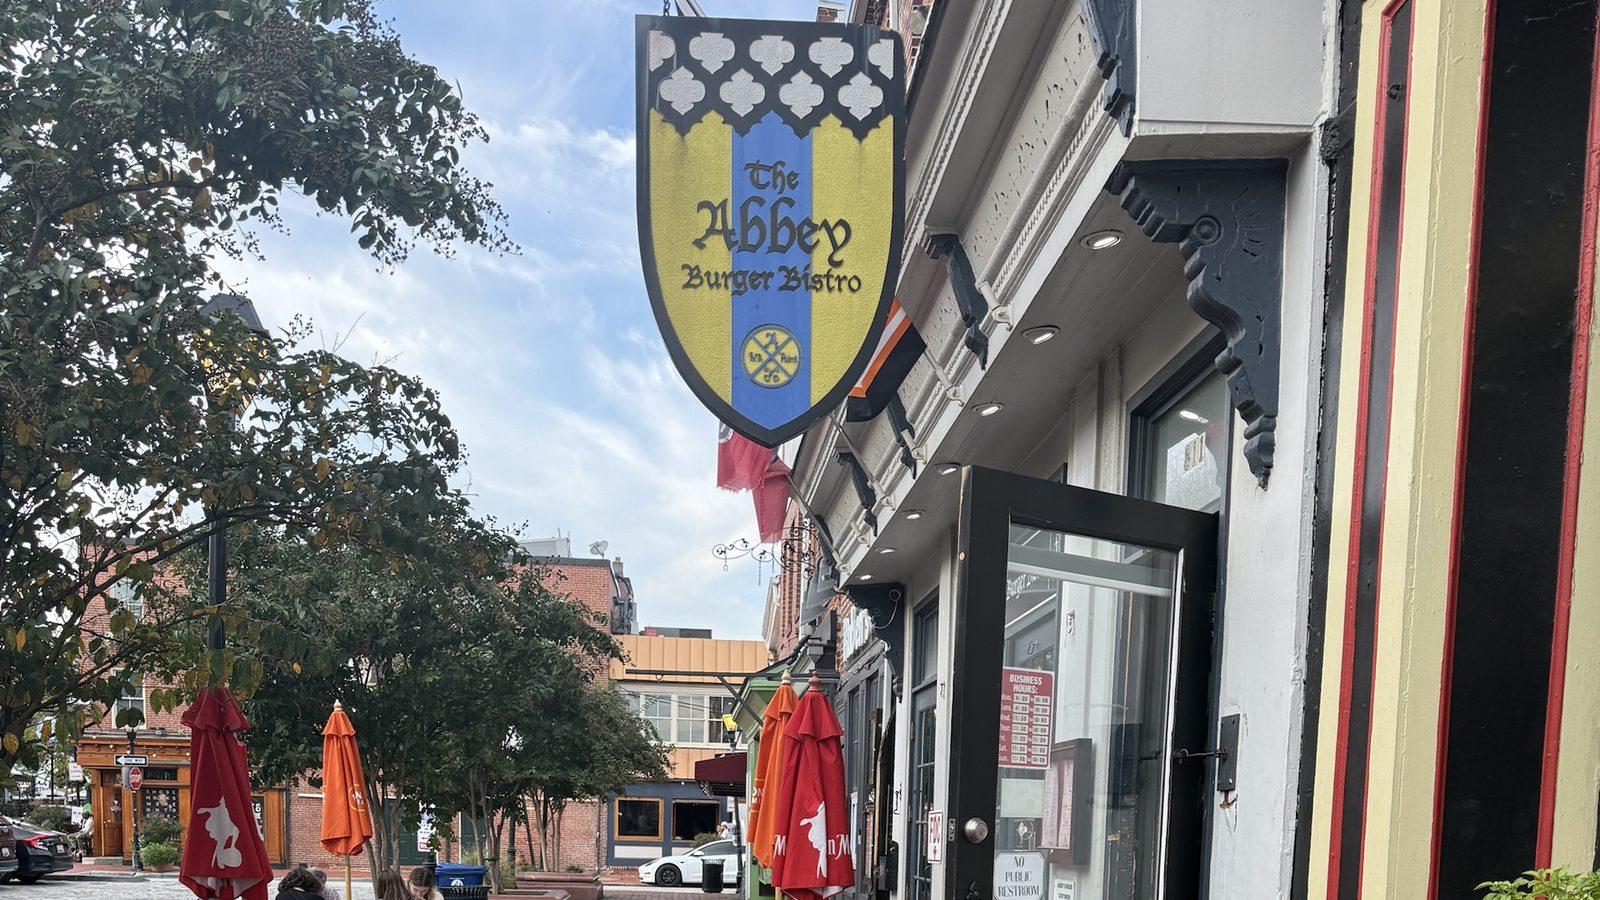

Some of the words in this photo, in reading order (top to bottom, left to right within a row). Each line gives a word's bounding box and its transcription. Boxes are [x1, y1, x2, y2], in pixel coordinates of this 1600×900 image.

[745, 159, 799, 194] The
[692, 196, 852, 268] Abbey
[681, 263, 775, 296] Burger
[778, 263, 862, 293] Bistro
[1009, 674, 1043, 686] BUSINESS
[1013, 683, 1038, 694] HOURS:
[129, 774, 142, 783] STOP
[1014, 855, 1025, 868] NO
[1005, 870, 1033, 883] PUBLIC
[998, 885, 1040, 897] RESTROOM
